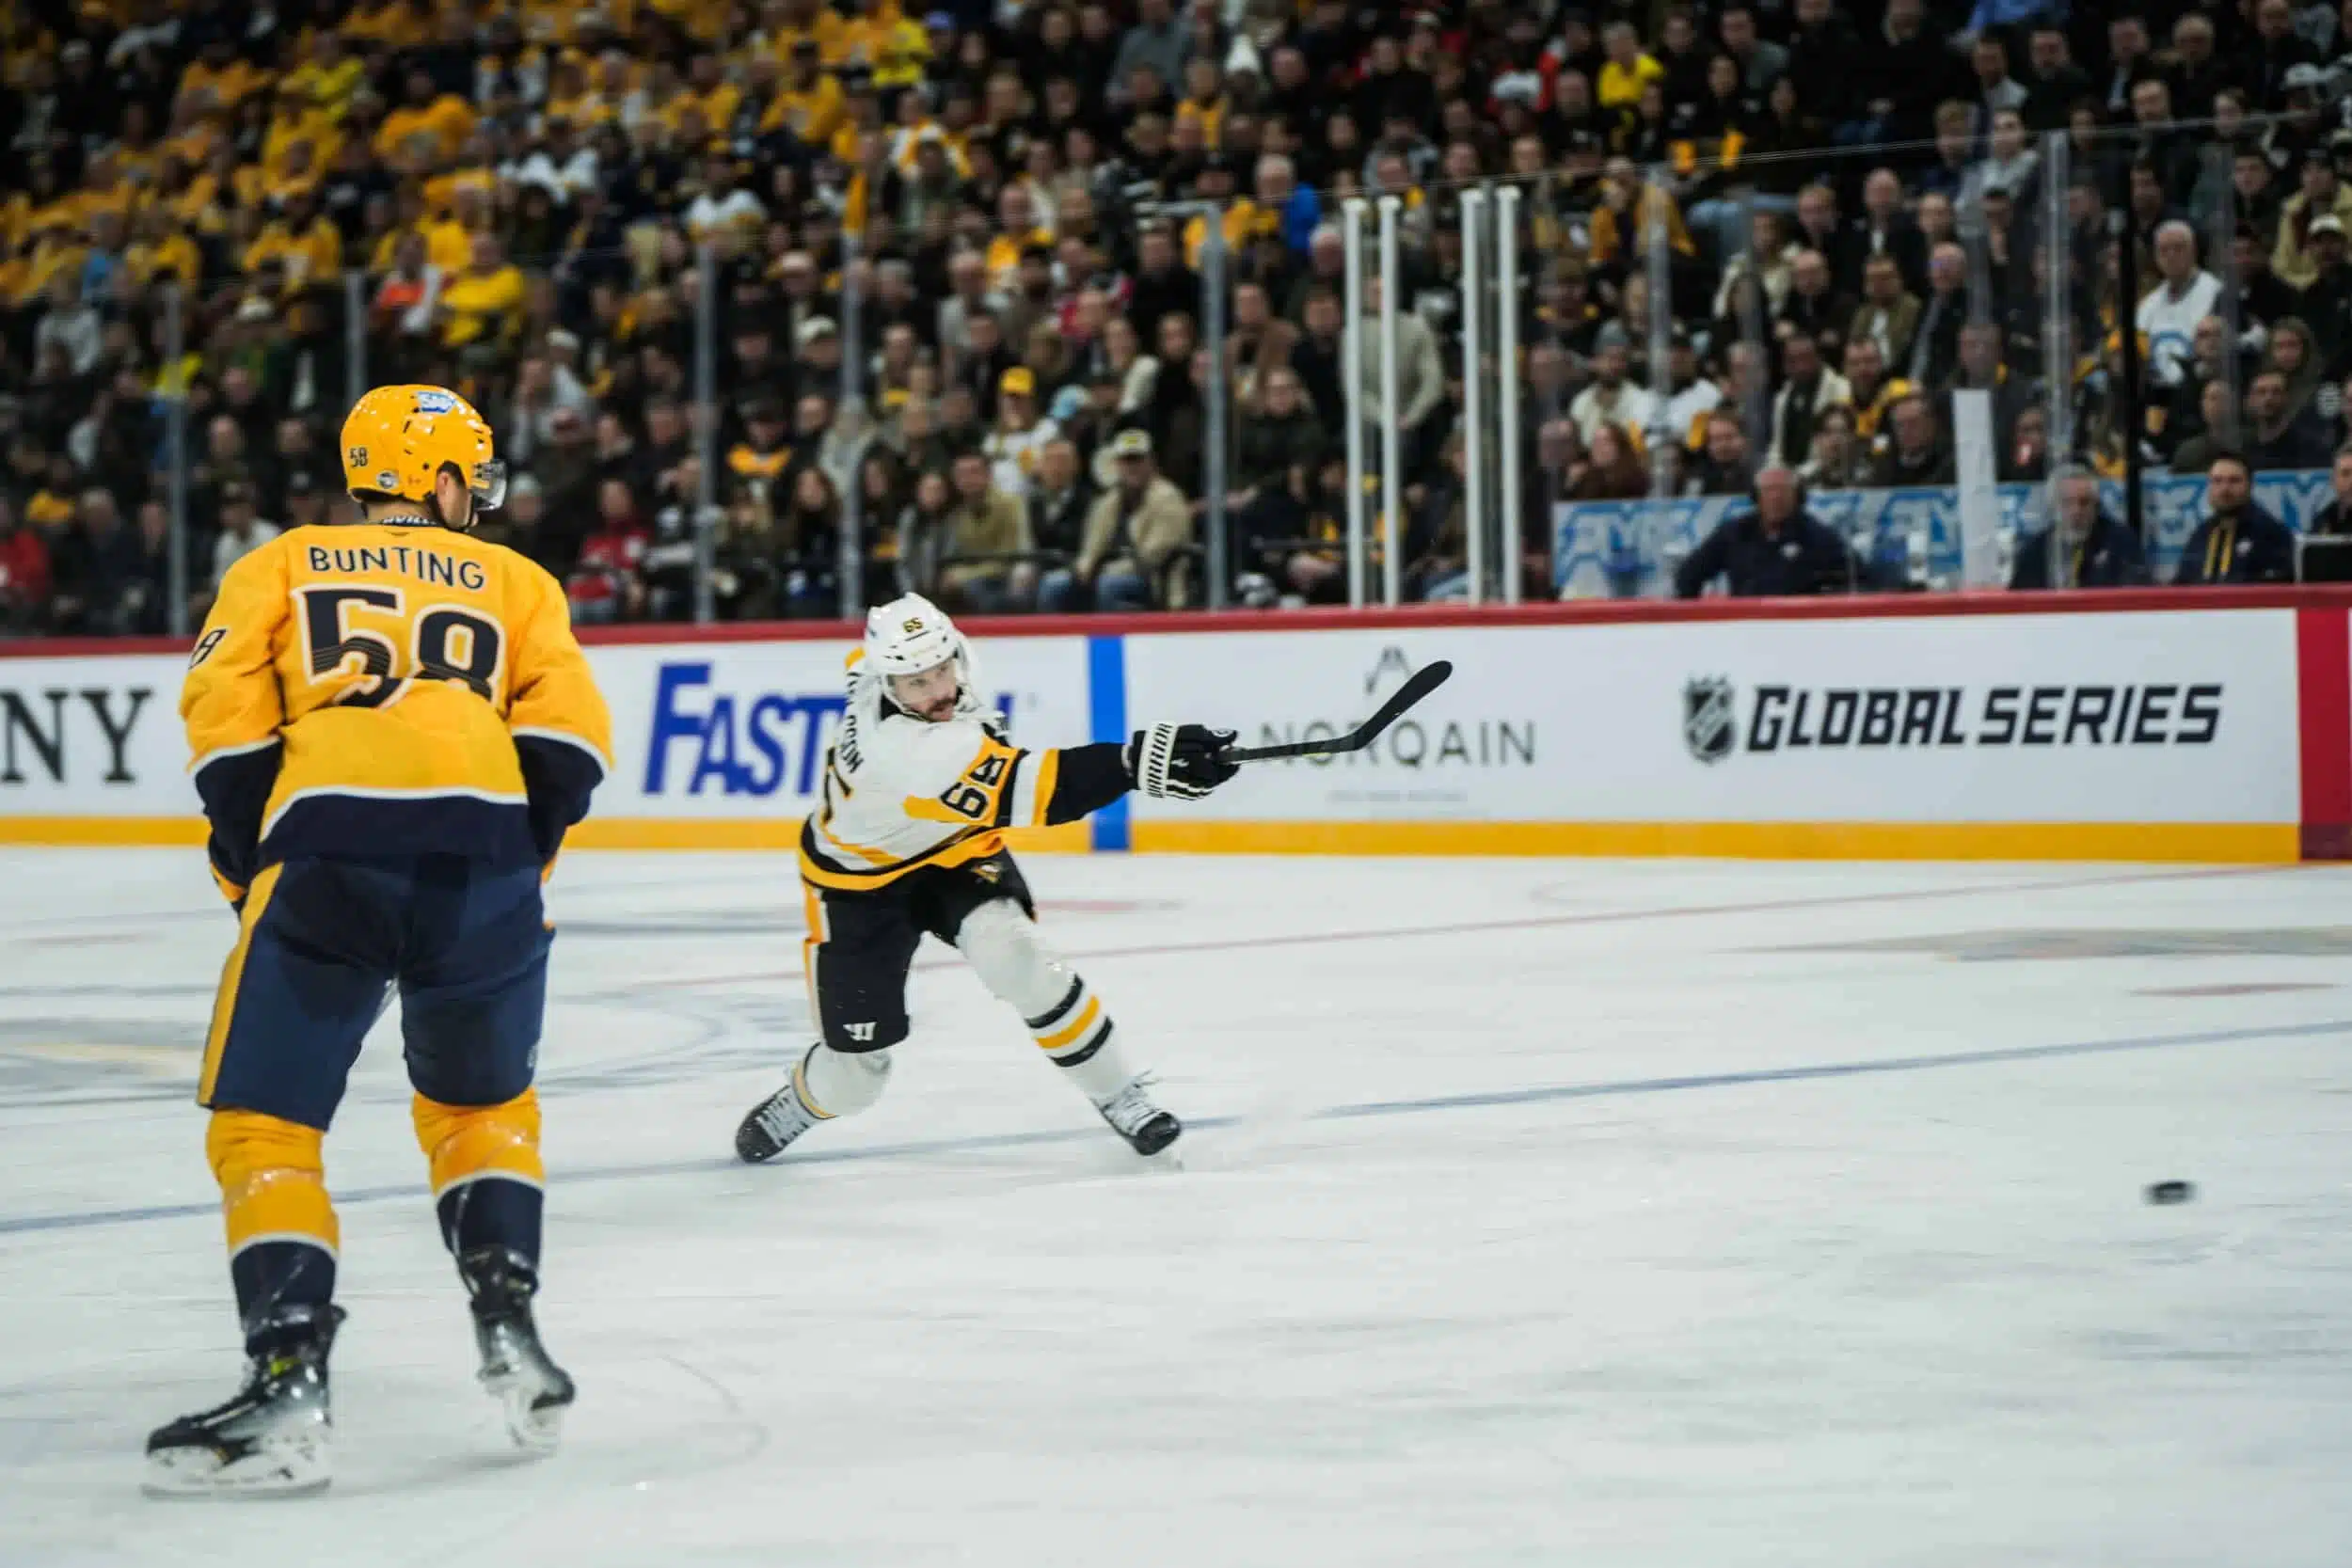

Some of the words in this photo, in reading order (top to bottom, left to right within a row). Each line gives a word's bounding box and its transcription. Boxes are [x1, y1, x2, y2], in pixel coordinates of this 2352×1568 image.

[310, 545, 486, 590] BUNTING
[187, 627, 229, 670] 8
[291, 583, 506, 710] 58
[1746, 686, 1966, 752] GLOBAL
[1978, 684, 2223, 745] SERIES
